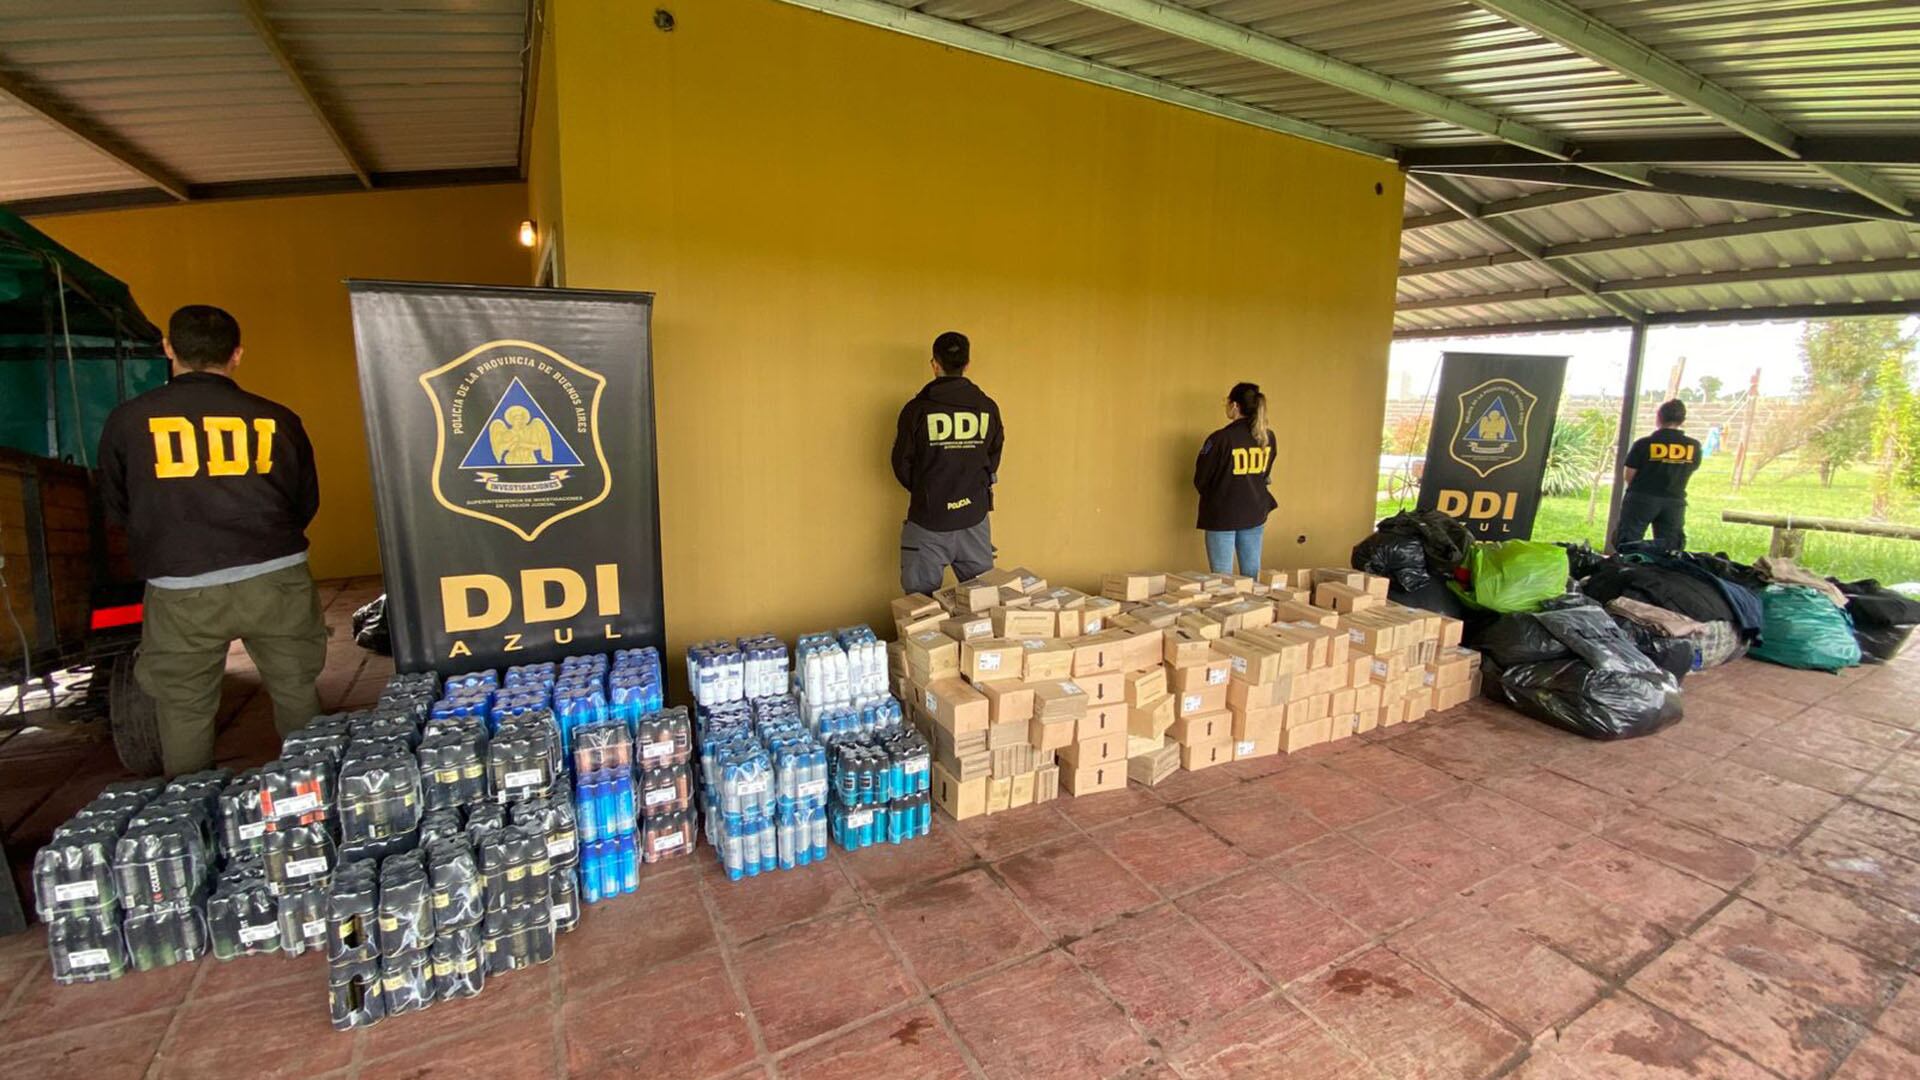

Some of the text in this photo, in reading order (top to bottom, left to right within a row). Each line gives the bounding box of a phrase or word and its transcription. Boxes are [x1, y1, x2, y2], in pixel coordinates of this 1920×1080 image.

[452, 356, 587, 435] POLICIA DE LA PROVINCIA DE BUENOS AIRES
[926, 412, 990, 441] DDI
[148, 416, 276, 478] DDI
[1231, 446, 1272, 475] DDI
[1650, 443, 1695, 460] DDI
[946, 497, 972, 511] POLICIA
[1436, 489, 1519, 520] DDI
[440, 563, 621, 633] DDI
[448, 624, 622, 658] AZUL
